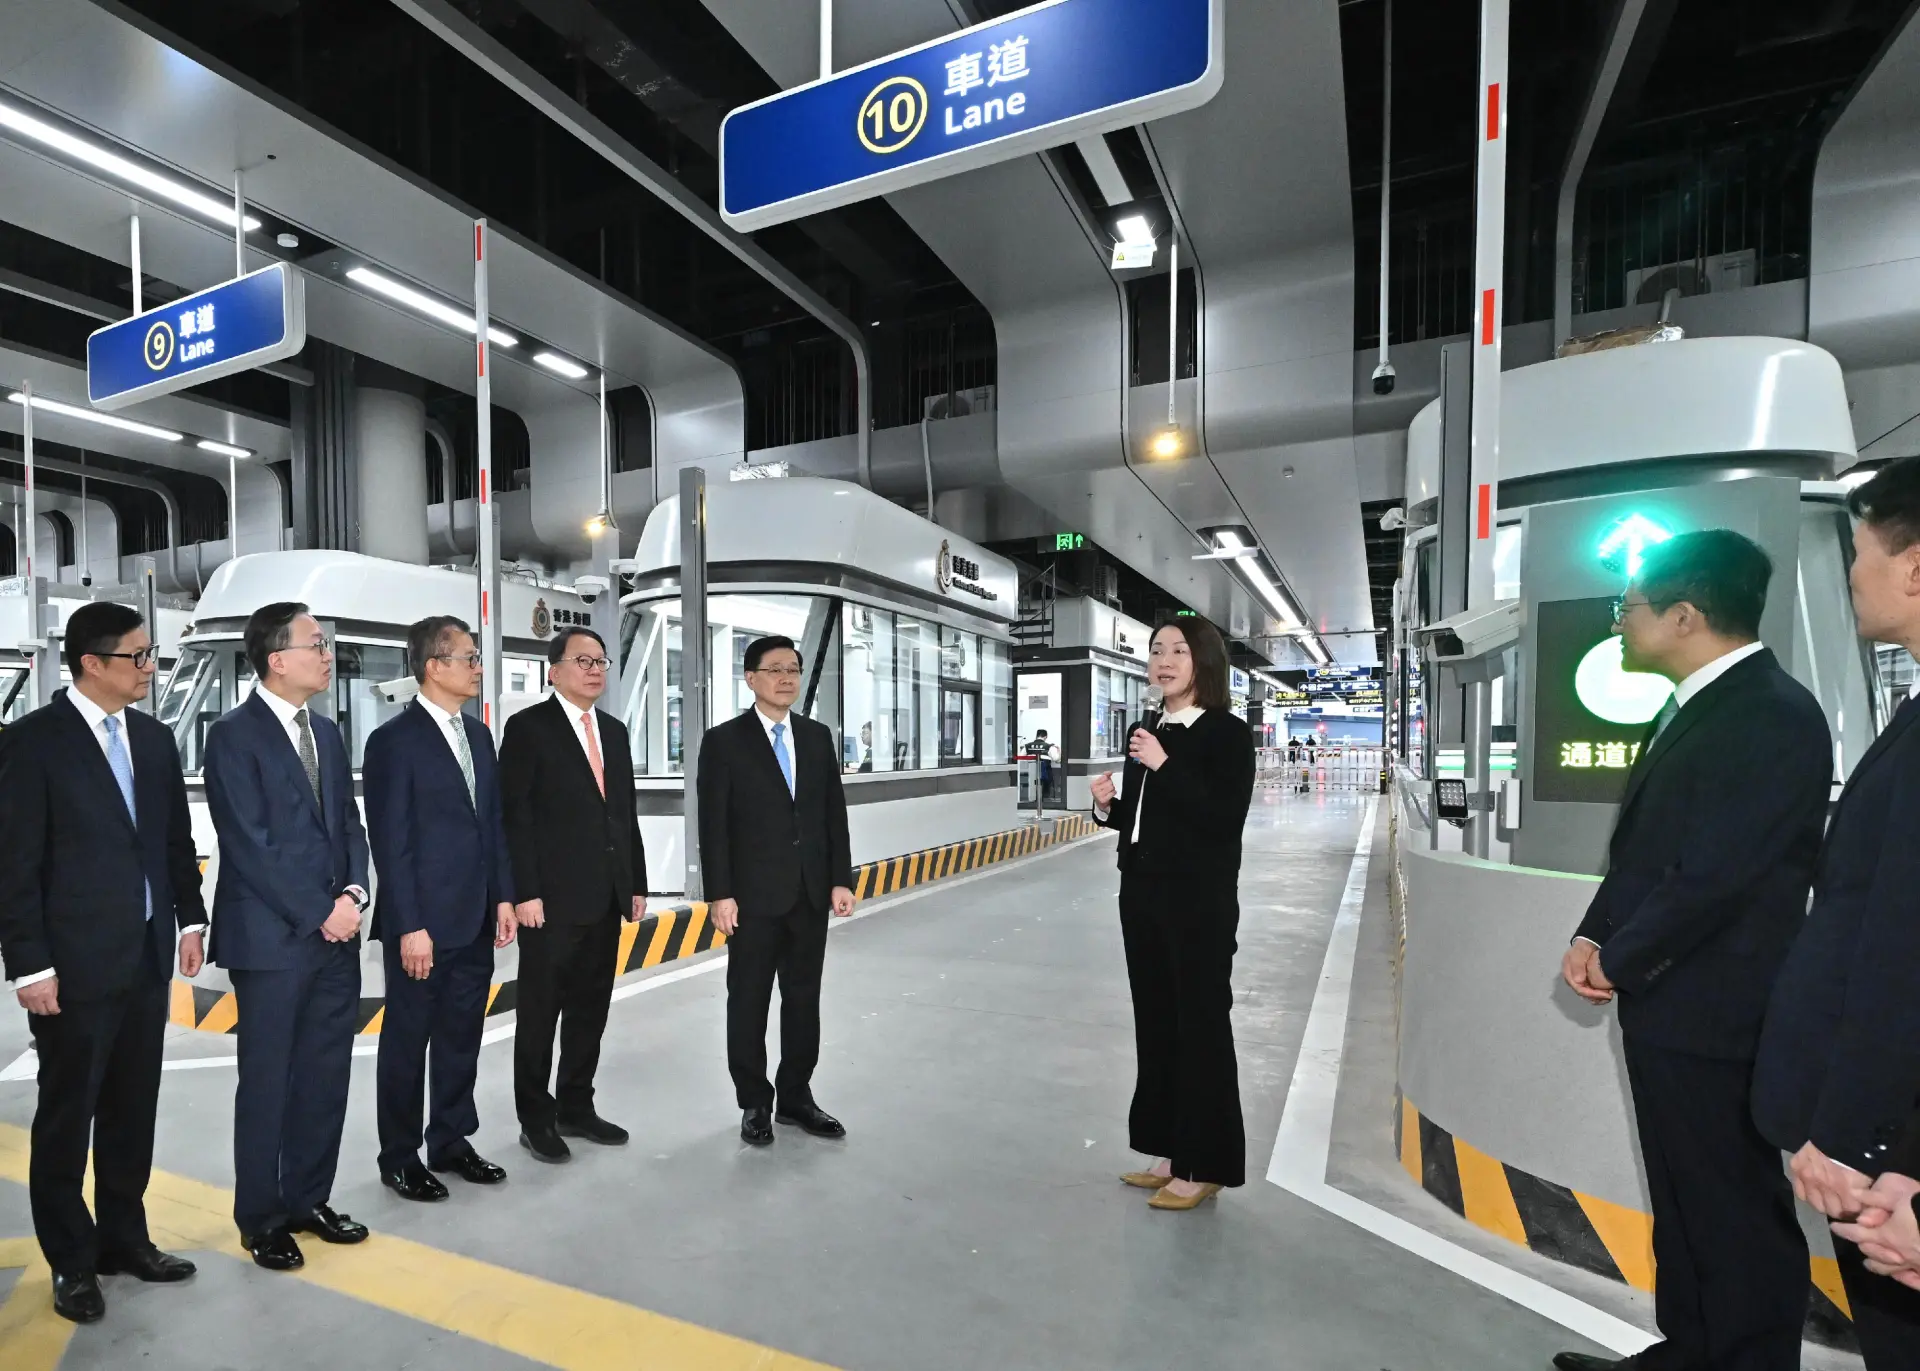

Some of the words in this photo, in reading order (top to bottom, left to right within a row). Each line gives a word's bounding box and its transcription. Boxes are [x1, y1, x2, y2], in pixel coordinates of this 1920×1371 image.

[944, 35, 1030, 96] 車道
[866, 92, 915, 140] 10
[944, 91, 1026, 135] Lane
[179, 303, 215, 338] 車道
[153, 333, 165, 360] 9
[180, 338, 215, 362] Lane
[1561, 741, 1641, 767] 通道
